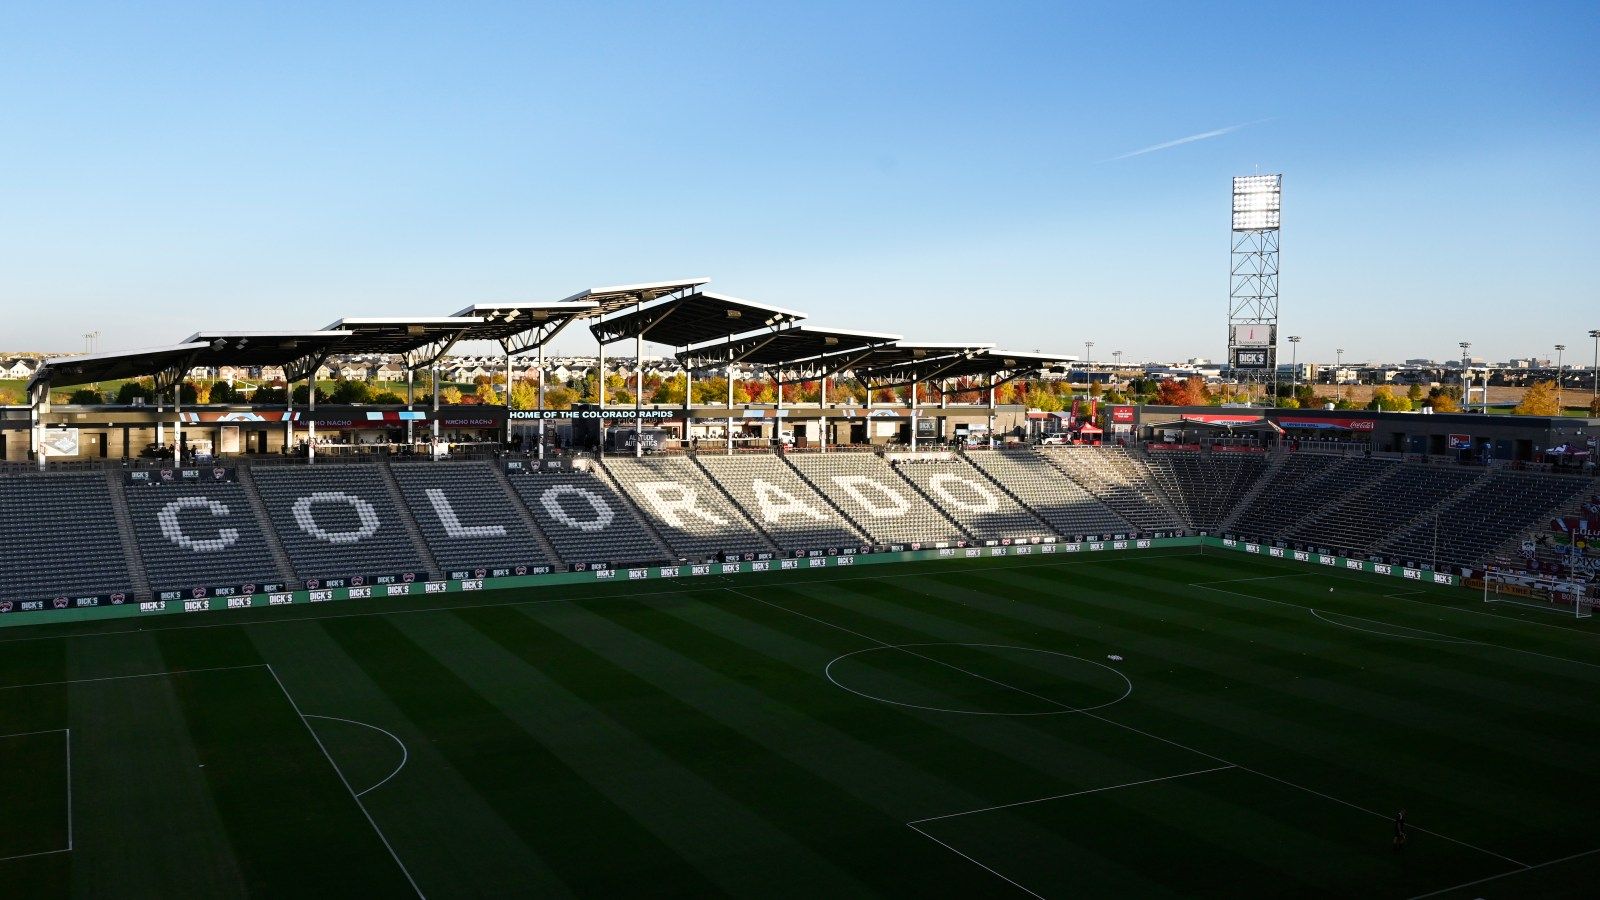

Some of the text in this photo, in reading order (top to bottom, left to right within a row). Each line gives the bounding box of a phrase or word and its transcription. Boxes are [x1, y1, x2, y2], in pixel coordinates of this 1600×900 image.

[1239, 353, 1264, 362] DICK'S
[510, 411, 540, 419] HOME
[543, 411, 557, 419] OF
[639, 410, 673, 418] RAPIDS
[157, 473, 1000, 552] COLORADO
[387, 584, 409, 594] DICK'S
[425, 582, 446, 592] DICK'S
[461, 580, 482, 590] DICK'S
[309, 590, 332, 600] DICK'S
[349, 587, 371, 597] DICK'S
[227, 597, 251, 607] DICK'S
[269, 593, 292, 604] DICK'S
[140, 601, 165, 610] DICK'S
[184, 600, 209, 610] DICK'S
